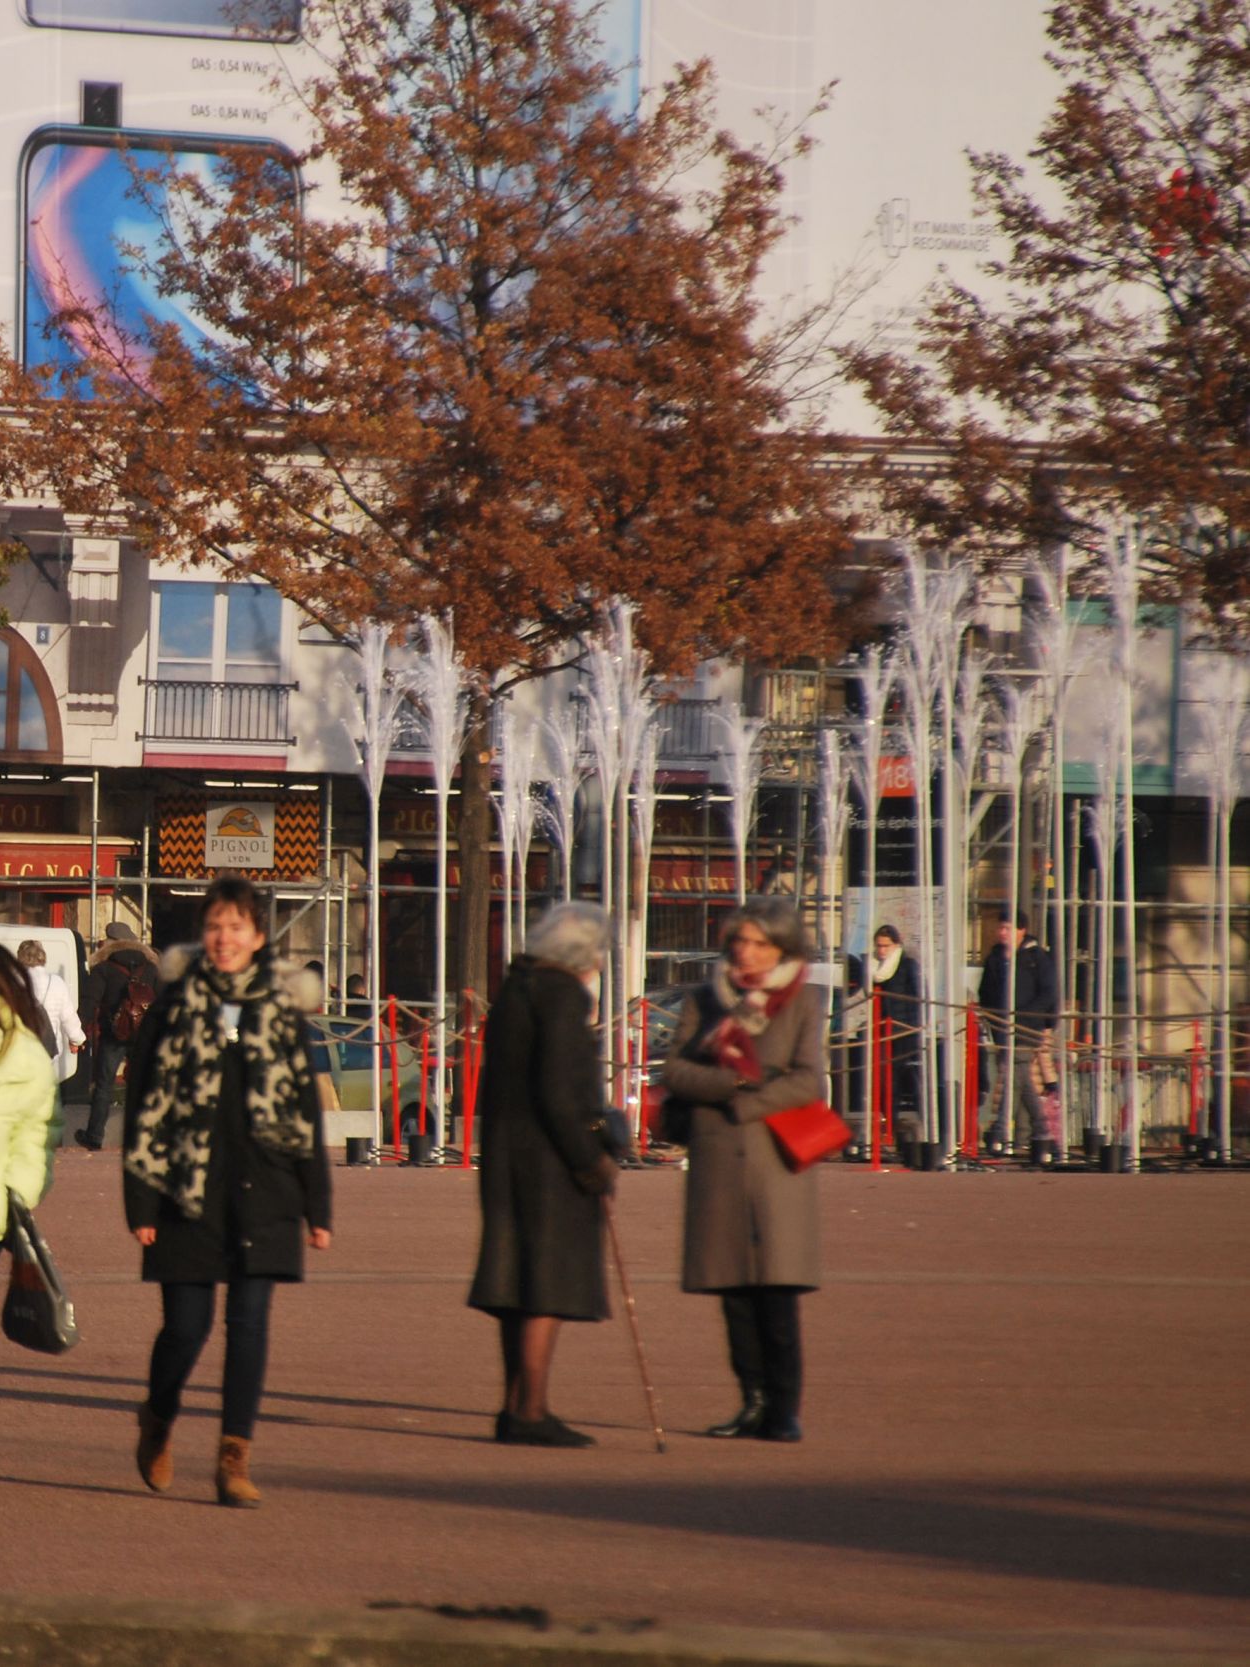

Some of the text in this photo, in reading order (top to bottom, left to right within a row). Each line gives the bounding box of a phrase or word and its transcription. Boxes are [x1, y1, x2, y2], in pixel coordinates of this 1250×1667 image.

[191, 58, 211, 70] DAS
[191, 104, 210, 117] DAS
[211, 839, 270, 853] PIGNOL
